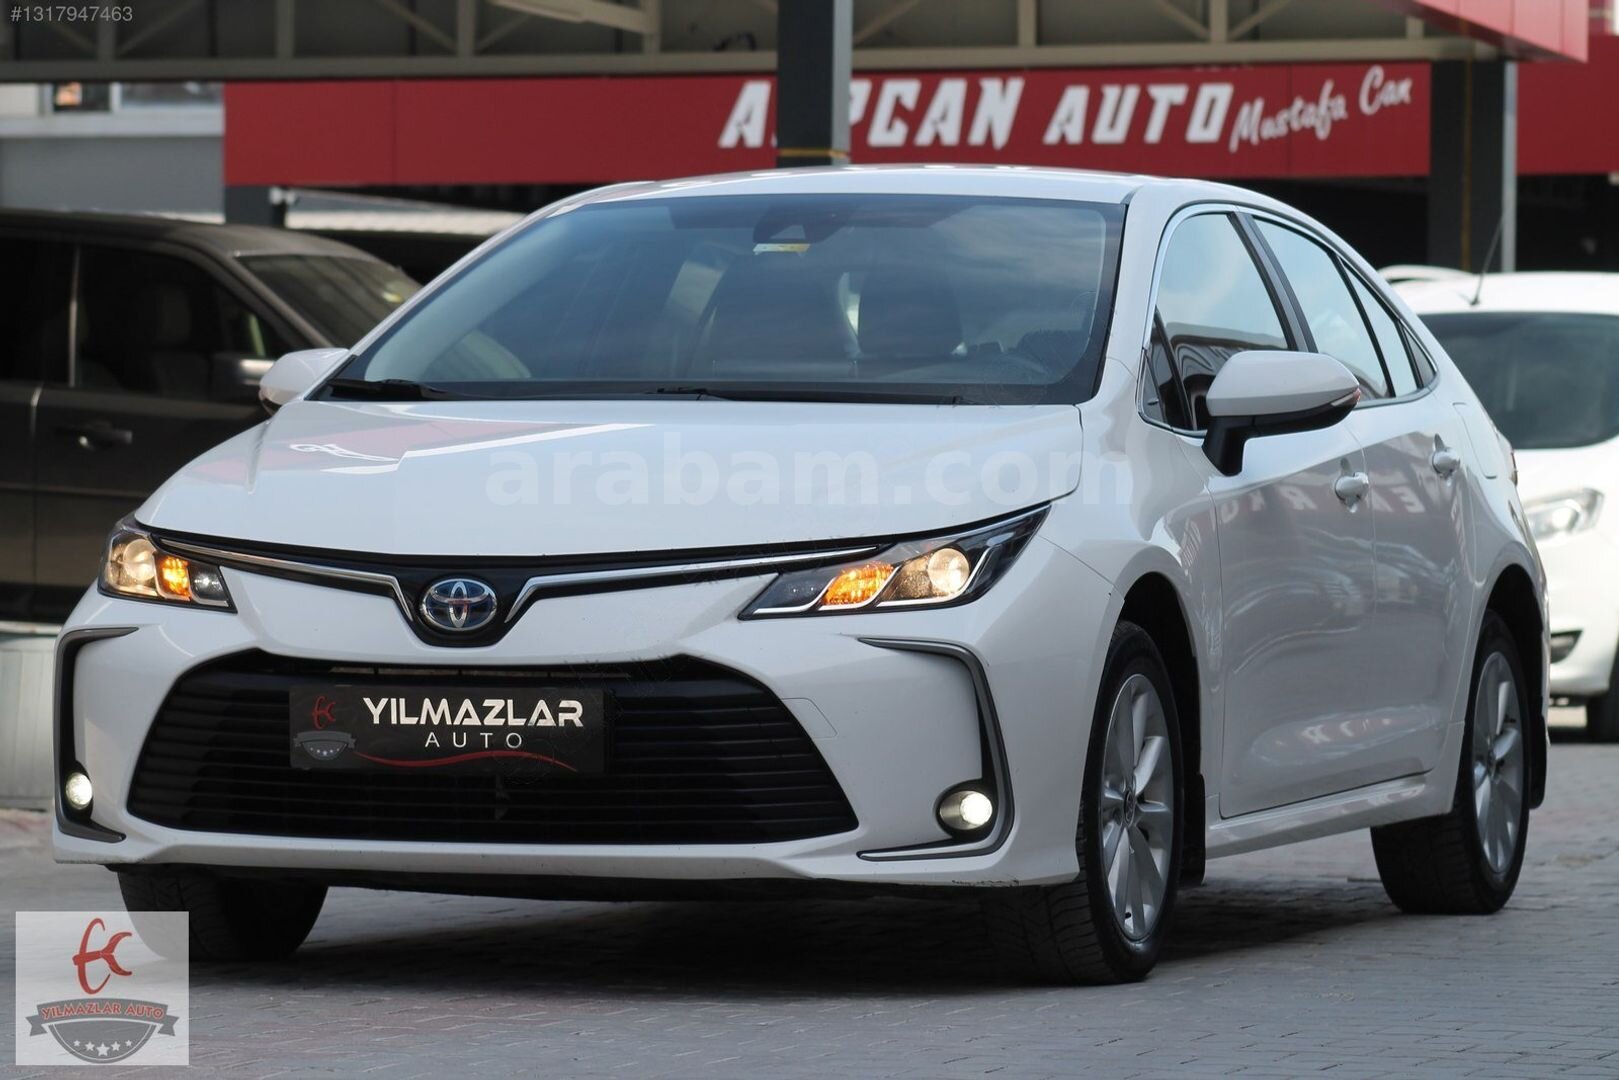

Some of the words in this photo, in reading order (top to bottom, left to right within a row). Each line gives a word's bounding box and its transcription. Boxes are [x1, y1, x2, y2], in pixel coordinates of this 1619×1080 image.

[717, 79, 1024, 148] ACAN
[1043, 84, 1233, 145] AUTO
[1229, 79, 1347, 153] Mustafa
[1359, 65, 1412, 115] Can
[363, 697, 584, 727] YILMAZLAR
[425, 732, 523, 749] AUTO
